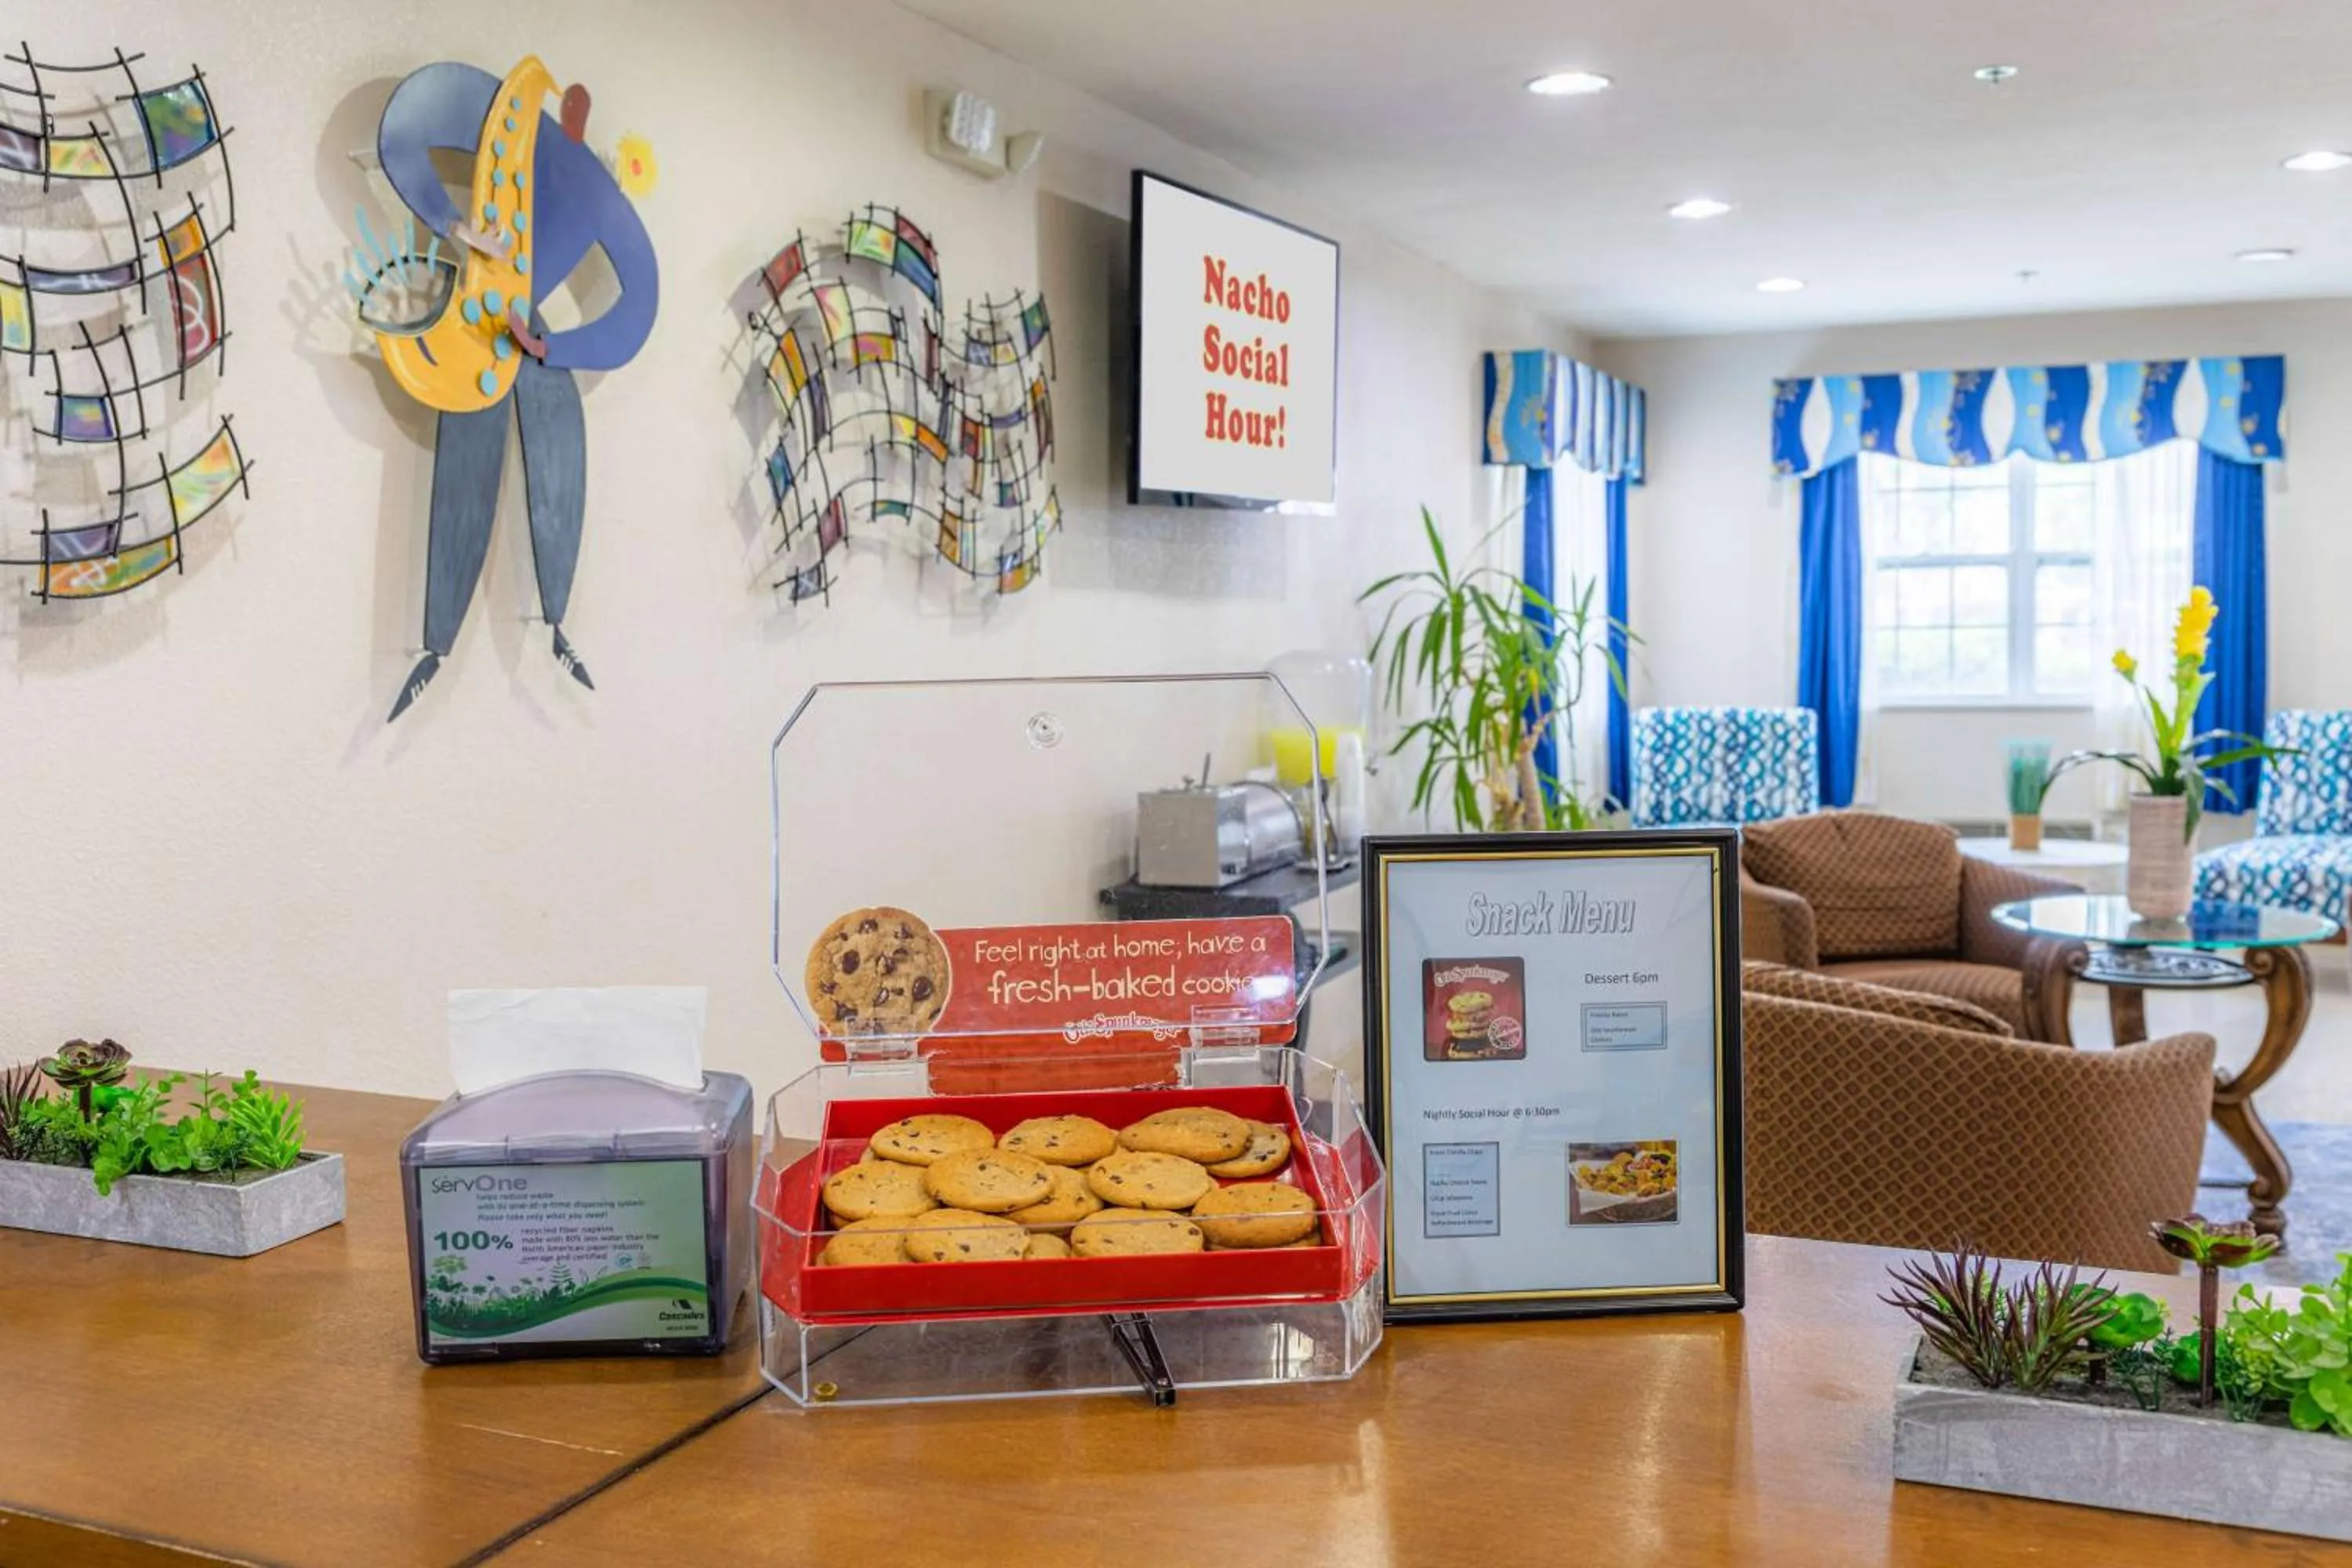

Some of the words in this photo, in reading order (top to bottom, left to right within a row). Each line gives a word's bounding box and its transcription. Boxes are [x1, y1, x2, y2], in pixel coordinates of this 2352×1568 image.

[1203, 255, 1290, 323] Nacho
[1203, 323, 1288, 387] Social
[1205, 391, 1286, 448] Hour!
[1466, 891, 1554, 937] Snack
[1559, 890, 1636, 934] Menu
[975, 938, 1022, 964] Feel
[1029, 935, 1081, 967] right
[1086, 942, 1107, 960] at
[1188, 931, 1244, 954] have
[1251, 936, 1266, 952] a
[988, 965, 1176, 1005] fresh-baked
[1584, 973, 1629, 984] Dessert
[1632, 972, 1659, 985] 6pm
[1423, 1109, 1457, 1120] Nightly
[1458, 1109, 1486, 1119] Social
[1488, 1108, 1510, 1117] Hour
[1513, 1107, 1523, 1119] @
[434, 1229, 514, 1251] 100%
